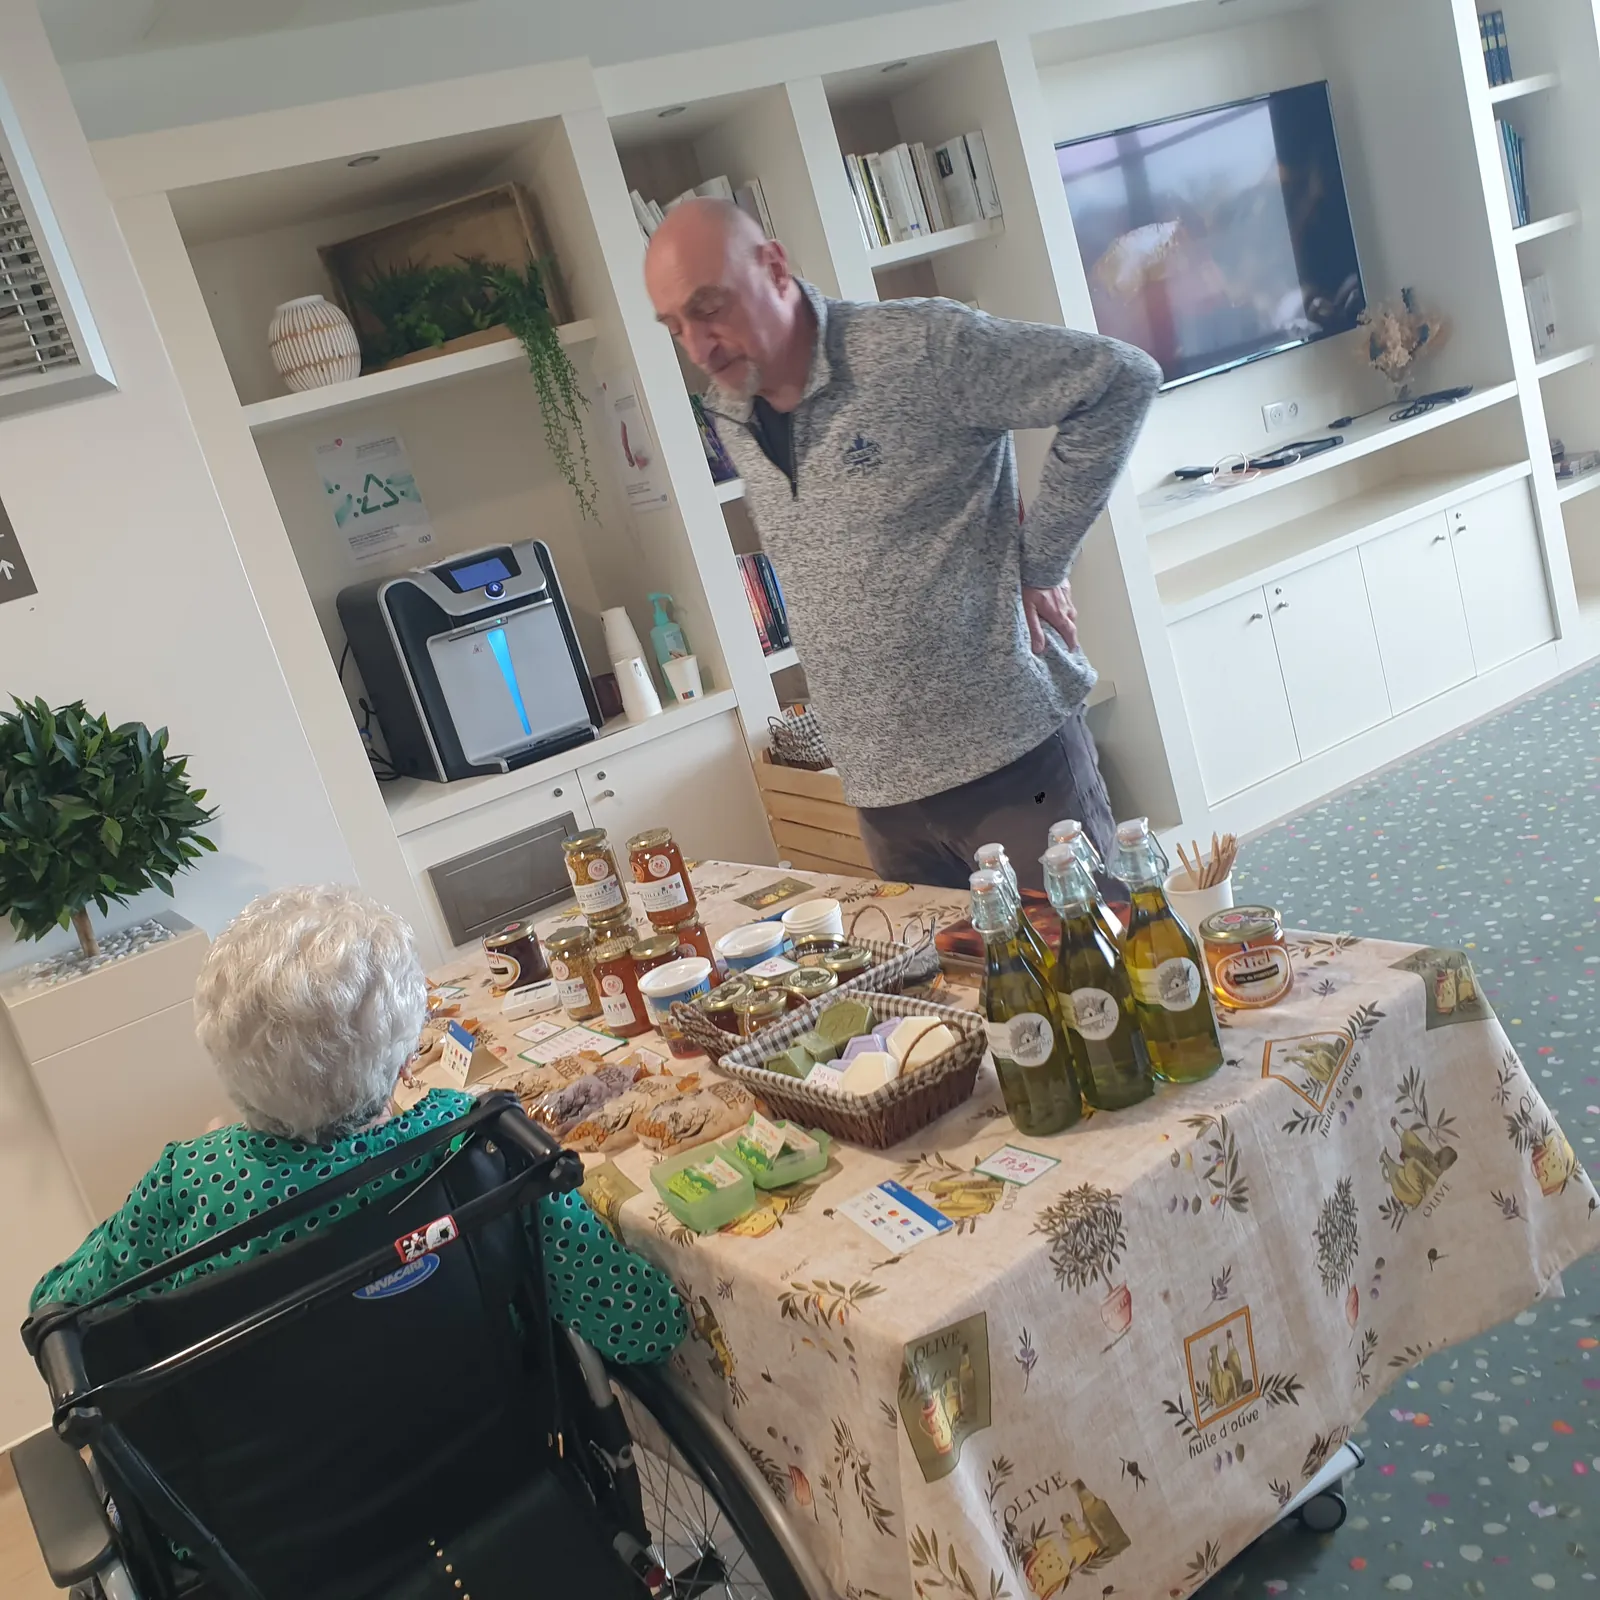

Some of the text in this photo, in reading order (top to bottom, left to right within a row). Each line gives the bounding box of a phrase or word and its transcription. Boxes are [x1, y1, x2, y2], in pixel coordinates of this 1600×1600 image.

[1232, 949, 1271, 969] Miel
[684, 984, 705, 1001] MIEL
[1319, 1100, 1337, 1139] huile
[1422, 1183, 1452, 1218] OLIVE
[364, 1258, 425, 1297] INVACARE
[913, 1328, 962, 1363] OLIVE
[1188, 1407, 1260, 1459] huile d'olive
[1002, 1470, 1069, 1525] OLIVE
